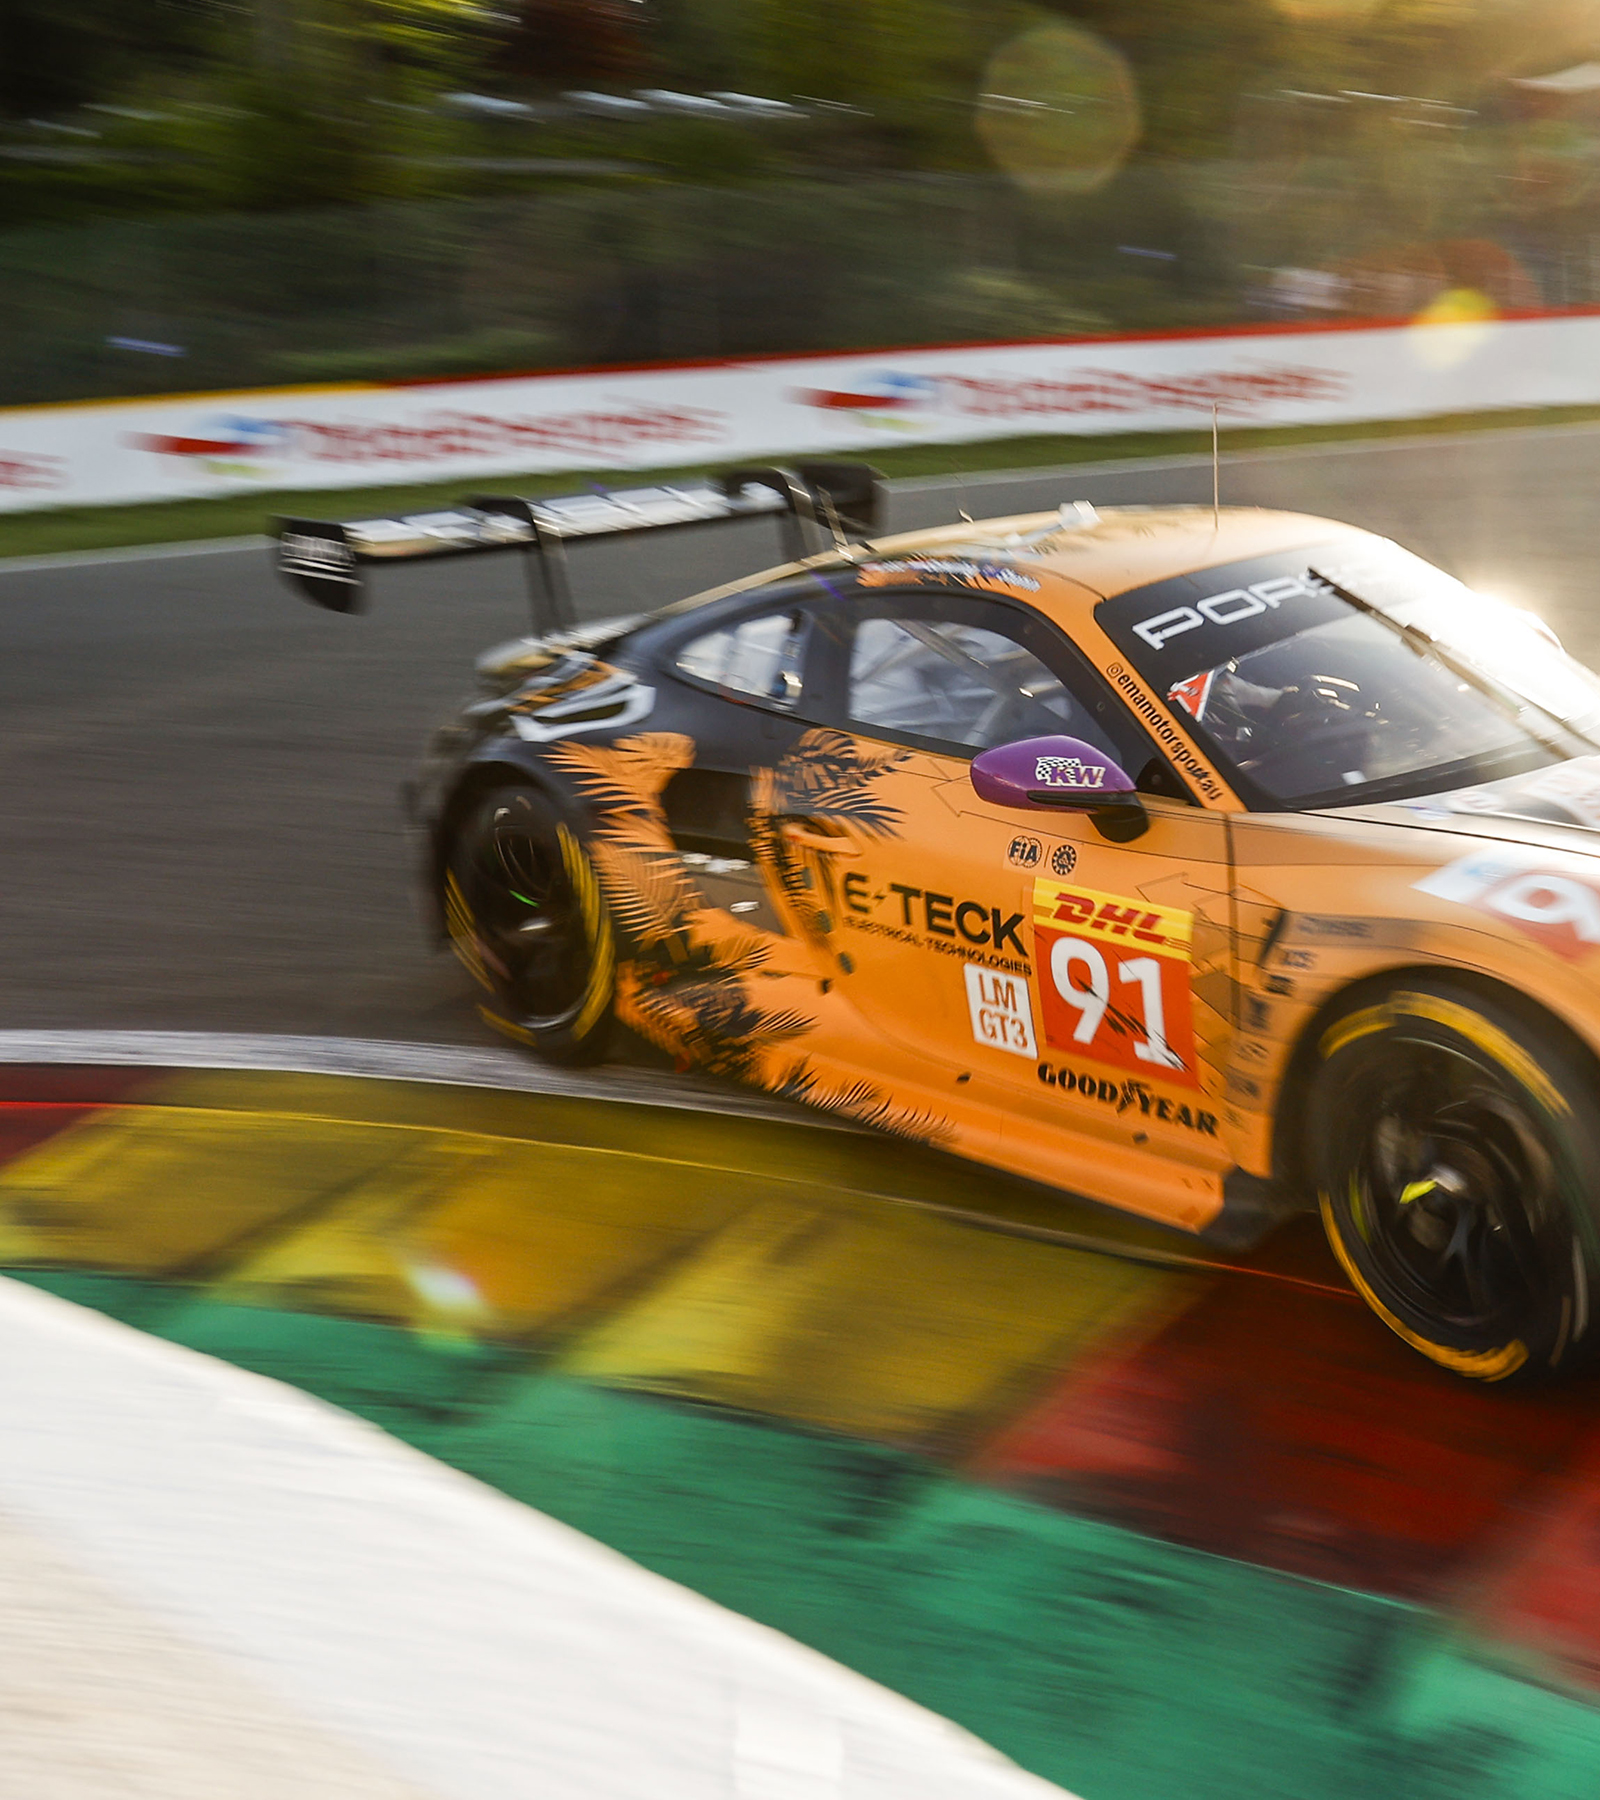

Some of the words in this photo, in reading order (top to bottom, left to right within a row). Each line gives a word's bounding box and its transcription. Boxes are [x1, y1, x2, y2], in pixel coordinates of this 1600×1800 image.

[1053, 892, 1167, 945] DHL
[979, 973, 1018, 1013] LM
[1051, 937, 1186, 1072] 91
[979, 1008, 1029, 1050] GT3
